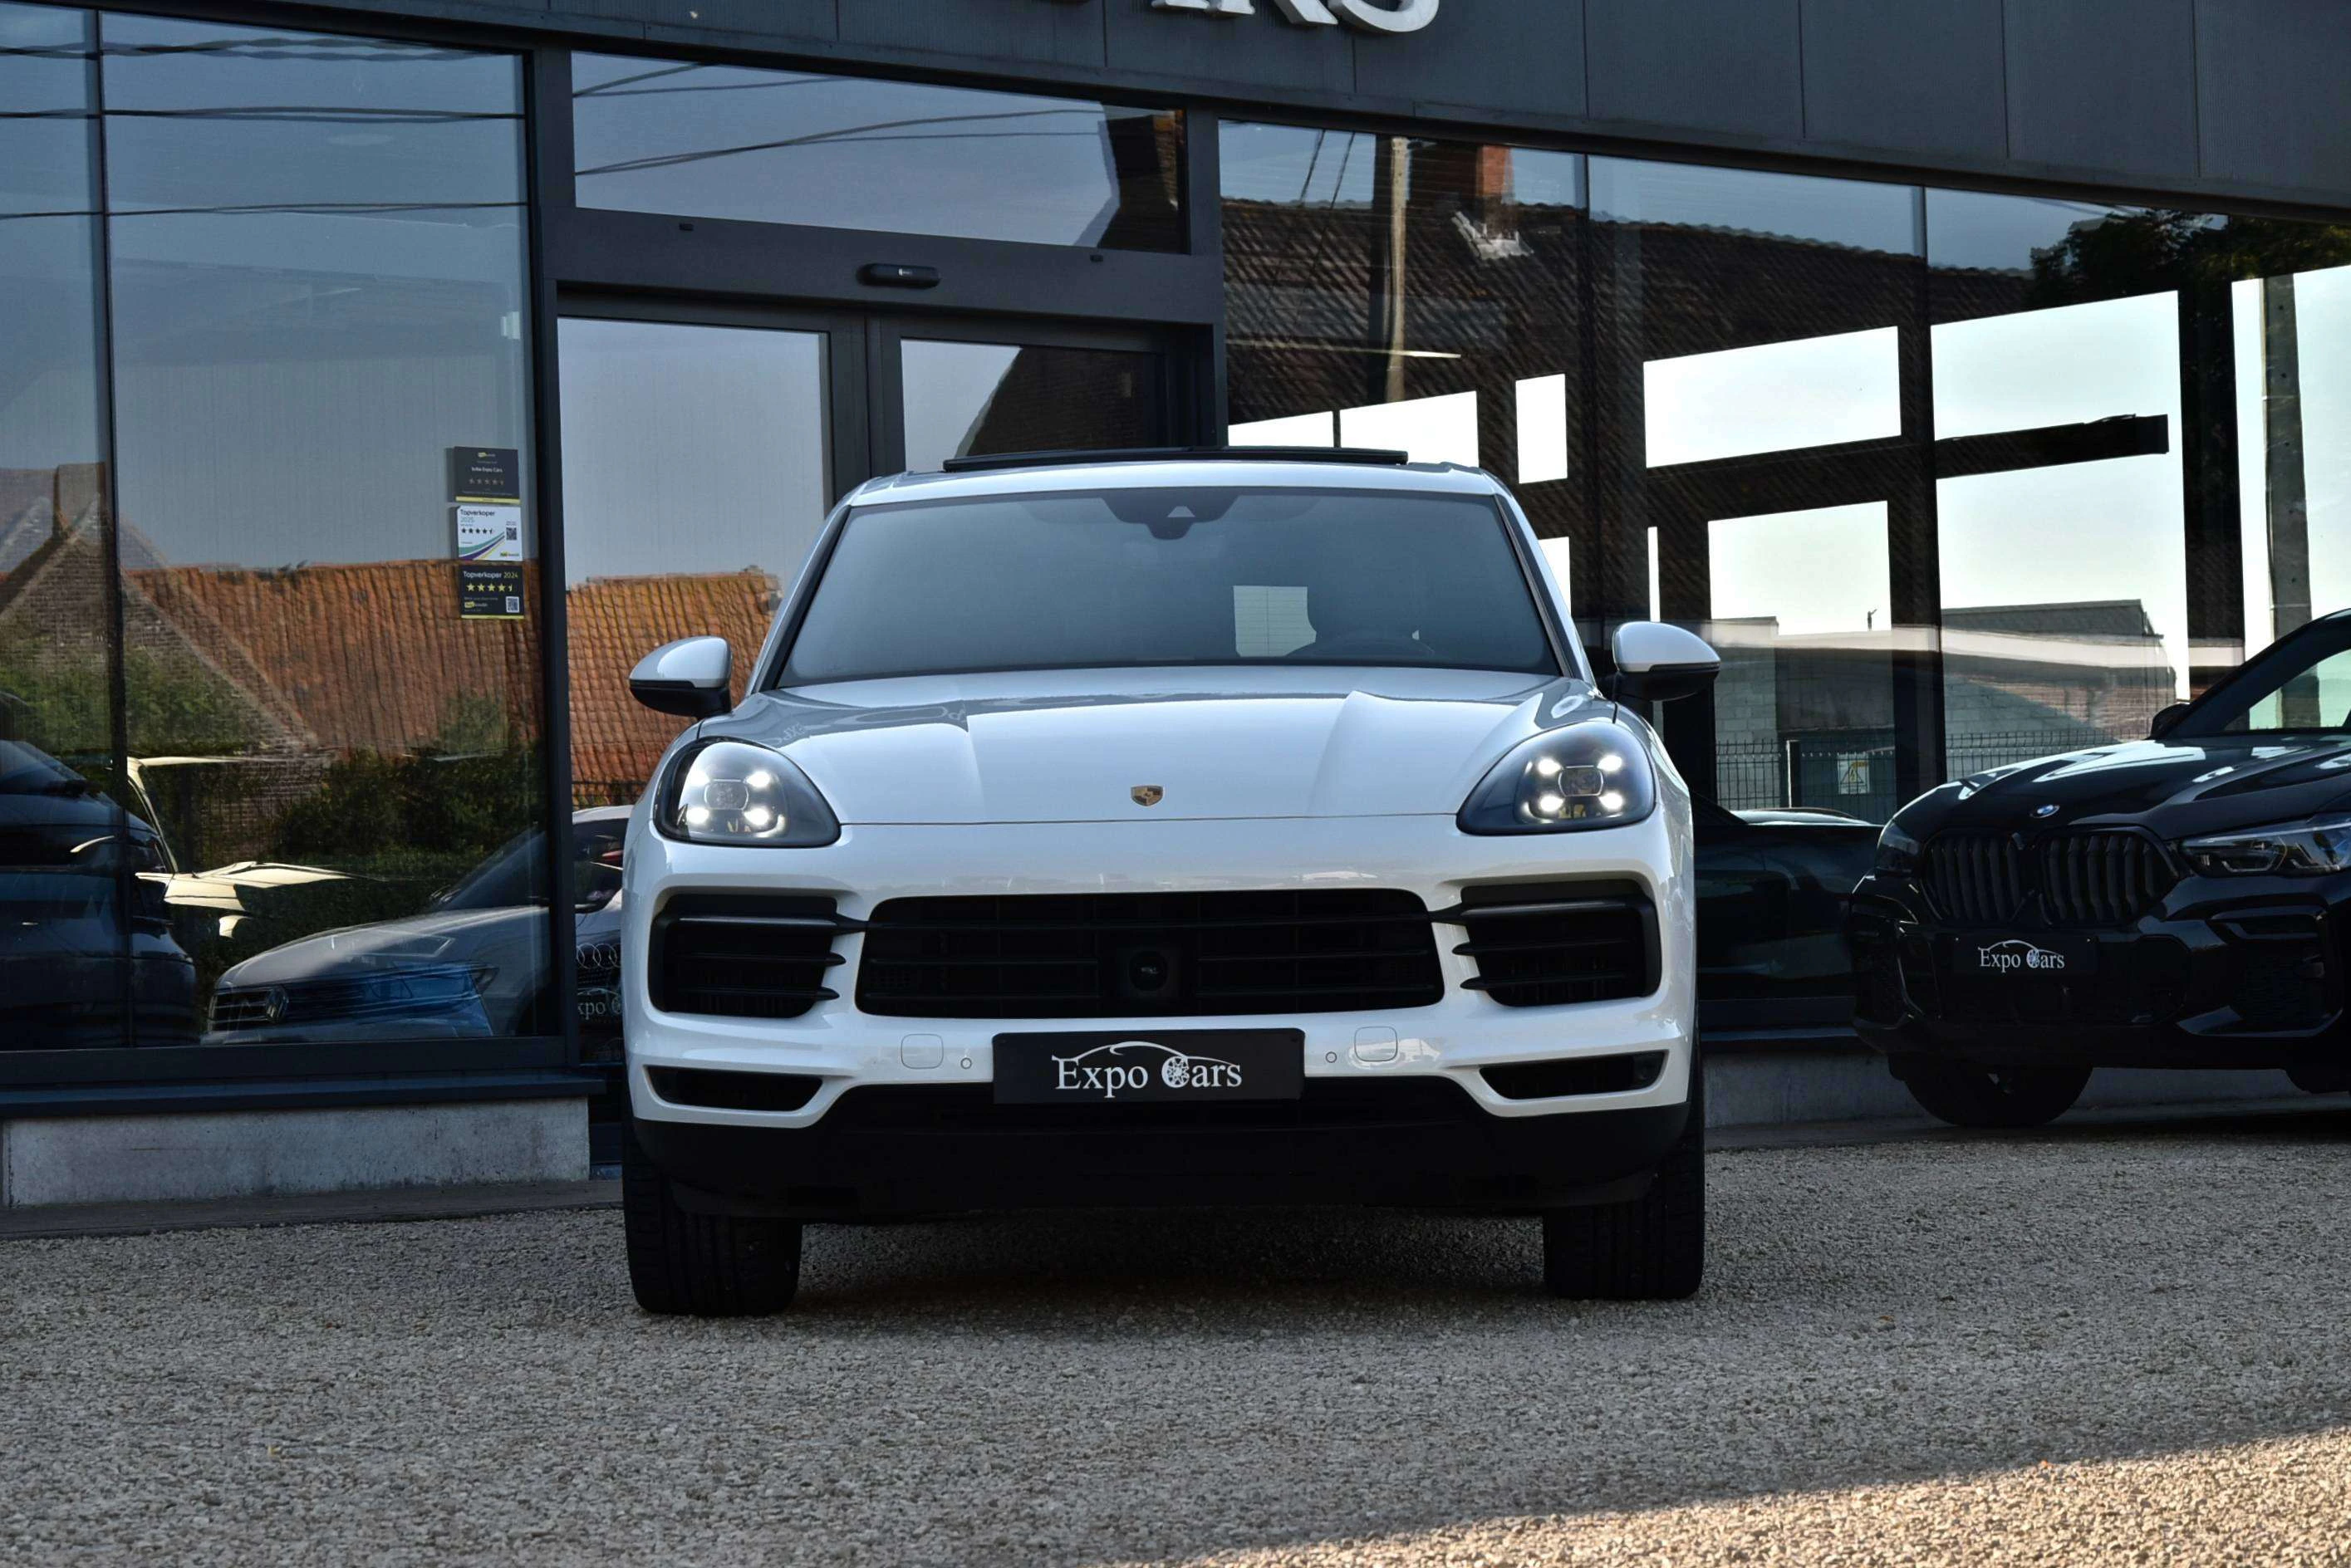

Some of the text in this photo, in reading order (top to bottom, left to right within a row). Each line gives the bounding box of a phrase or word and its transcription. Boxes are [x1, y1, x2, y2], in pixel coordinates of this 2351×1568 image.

[459, 508, 496, 517] Topverkoper
[463, 571, 503, 579] Topverkoper
[1980, 949, 2065, 973] Expo Cars
[577, 1002, 606, 1021] xpo
[1054, 1056, 1244, 1099] Expo Cars
